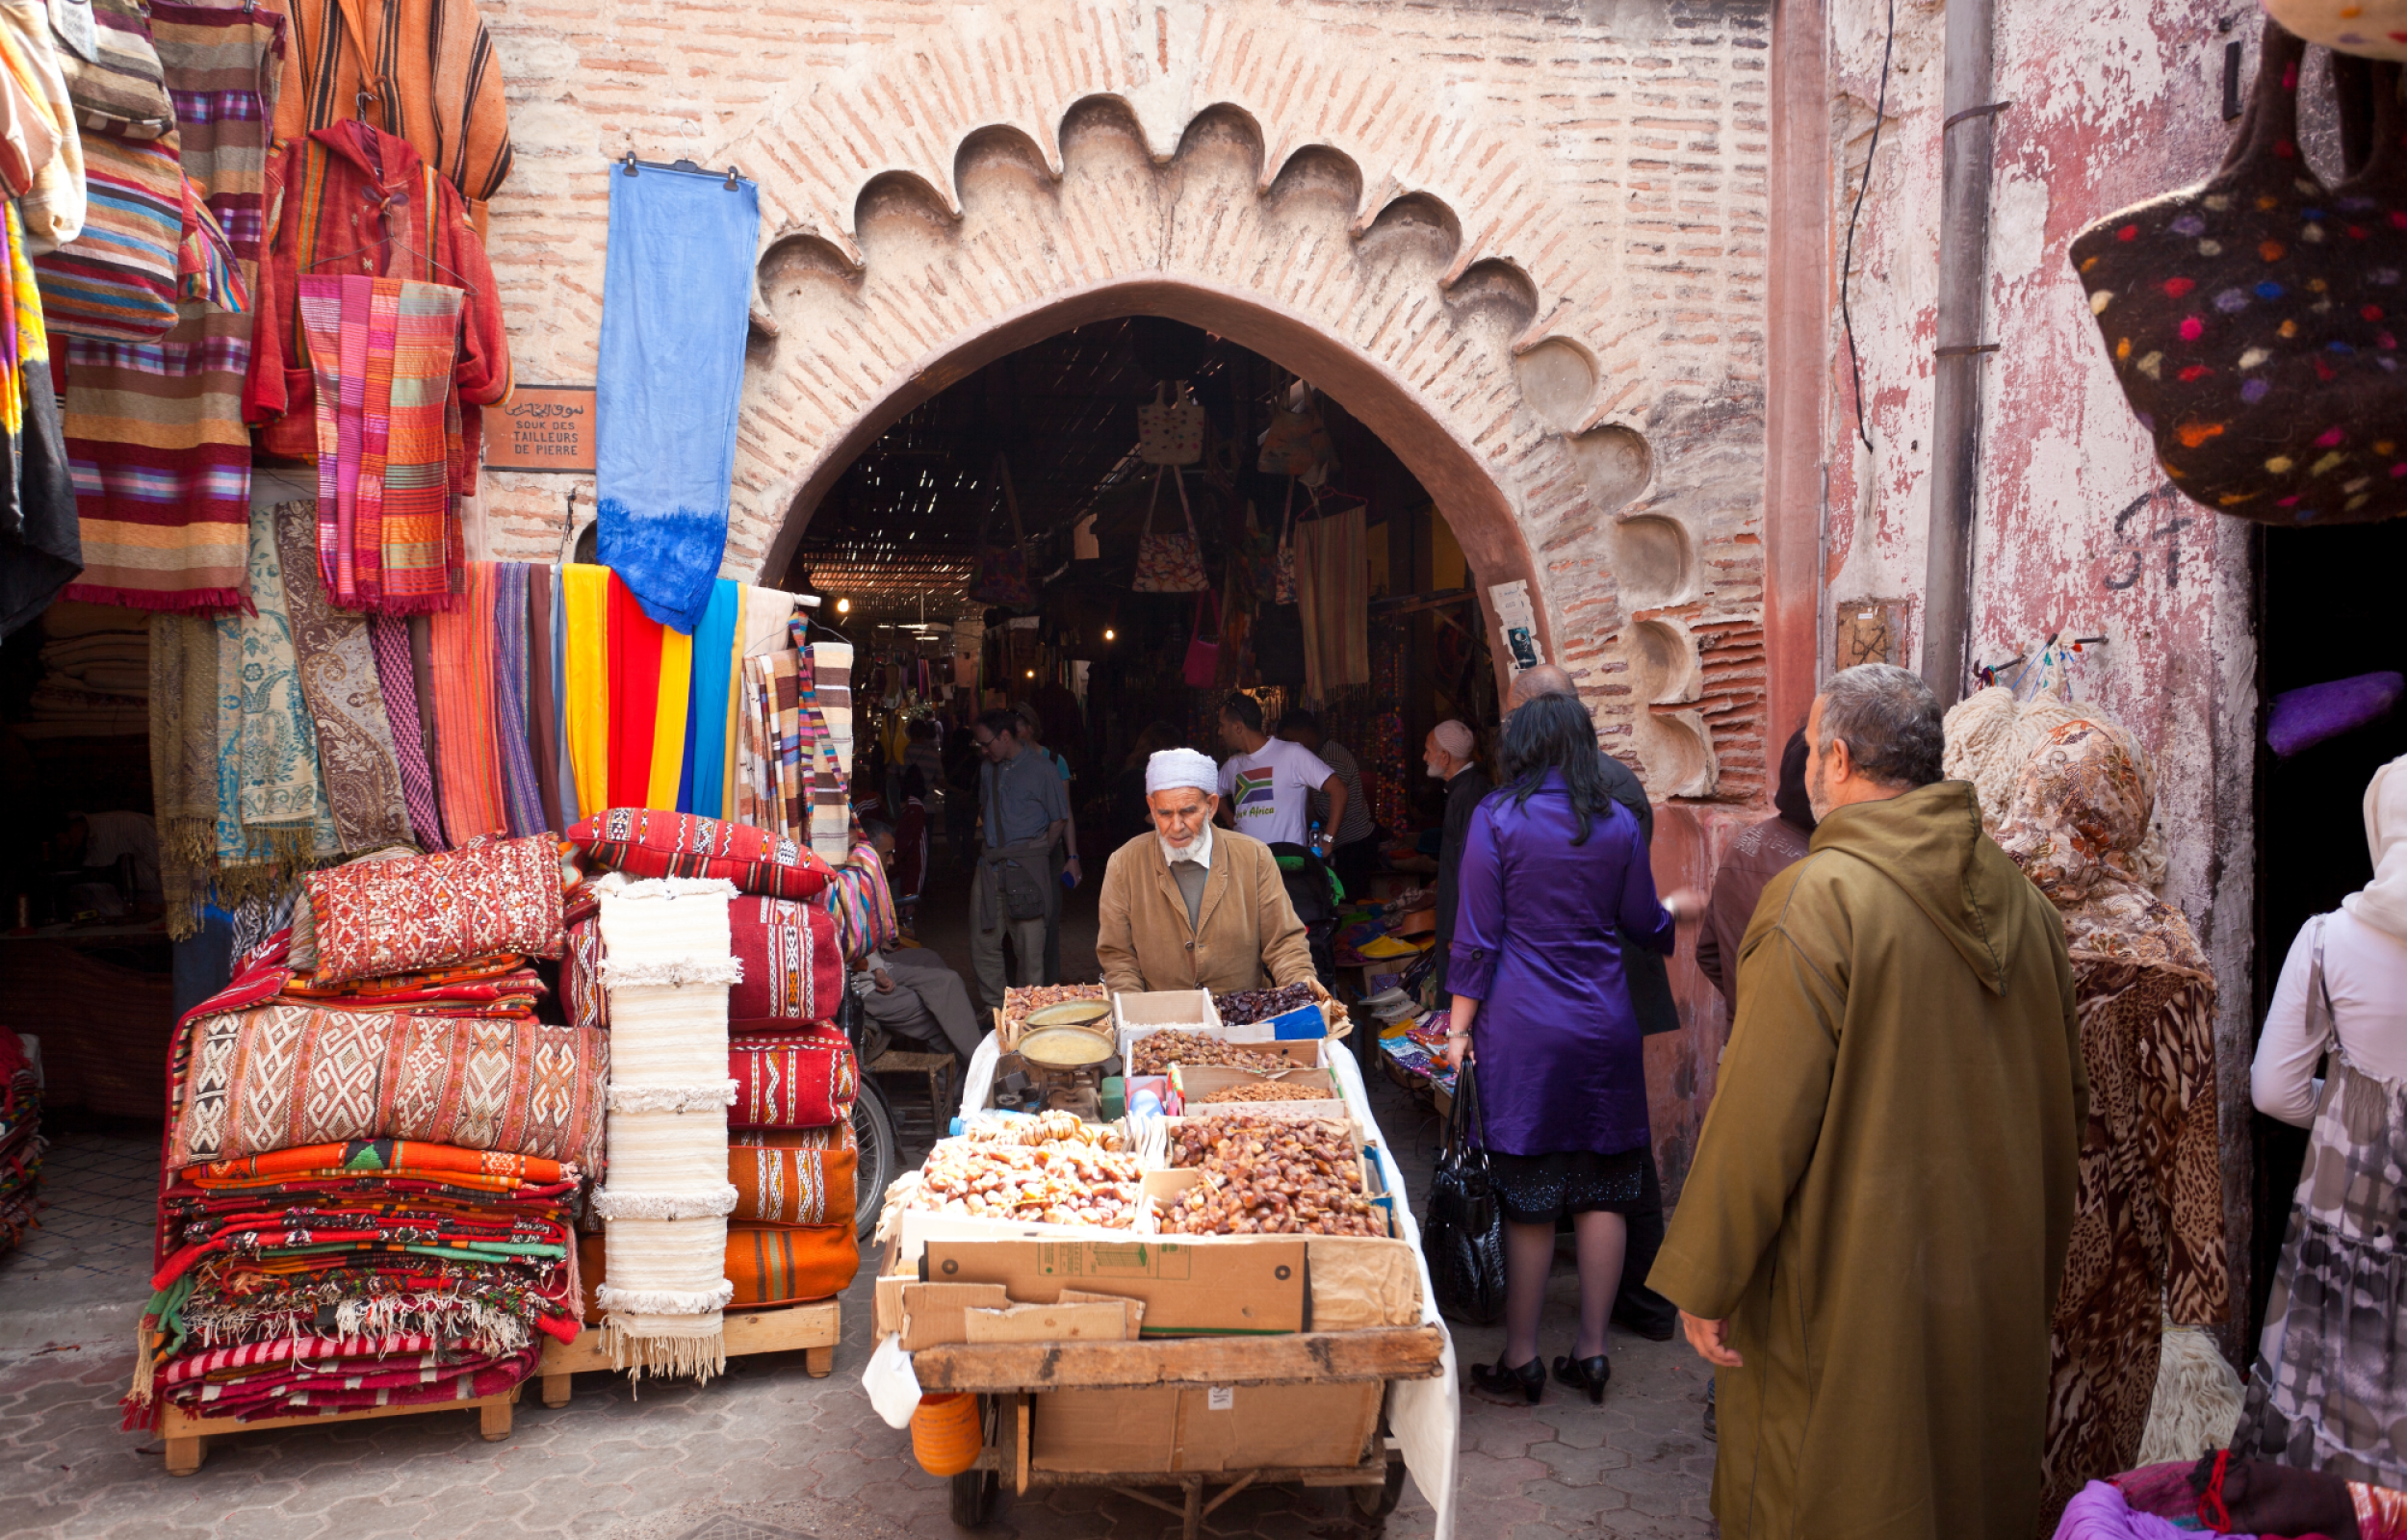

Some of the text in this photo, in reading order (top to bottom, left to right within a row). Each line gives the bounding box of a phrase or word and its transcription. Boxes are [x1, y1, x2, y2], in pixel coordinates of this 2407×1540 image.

[516, 421, 575, 430] SOUK DES
[513, 431, 579, 443] TAILLEURS
[515, 444, 578, 455] DE PIERRE
[1249, 806, 1275, 818] Africa
